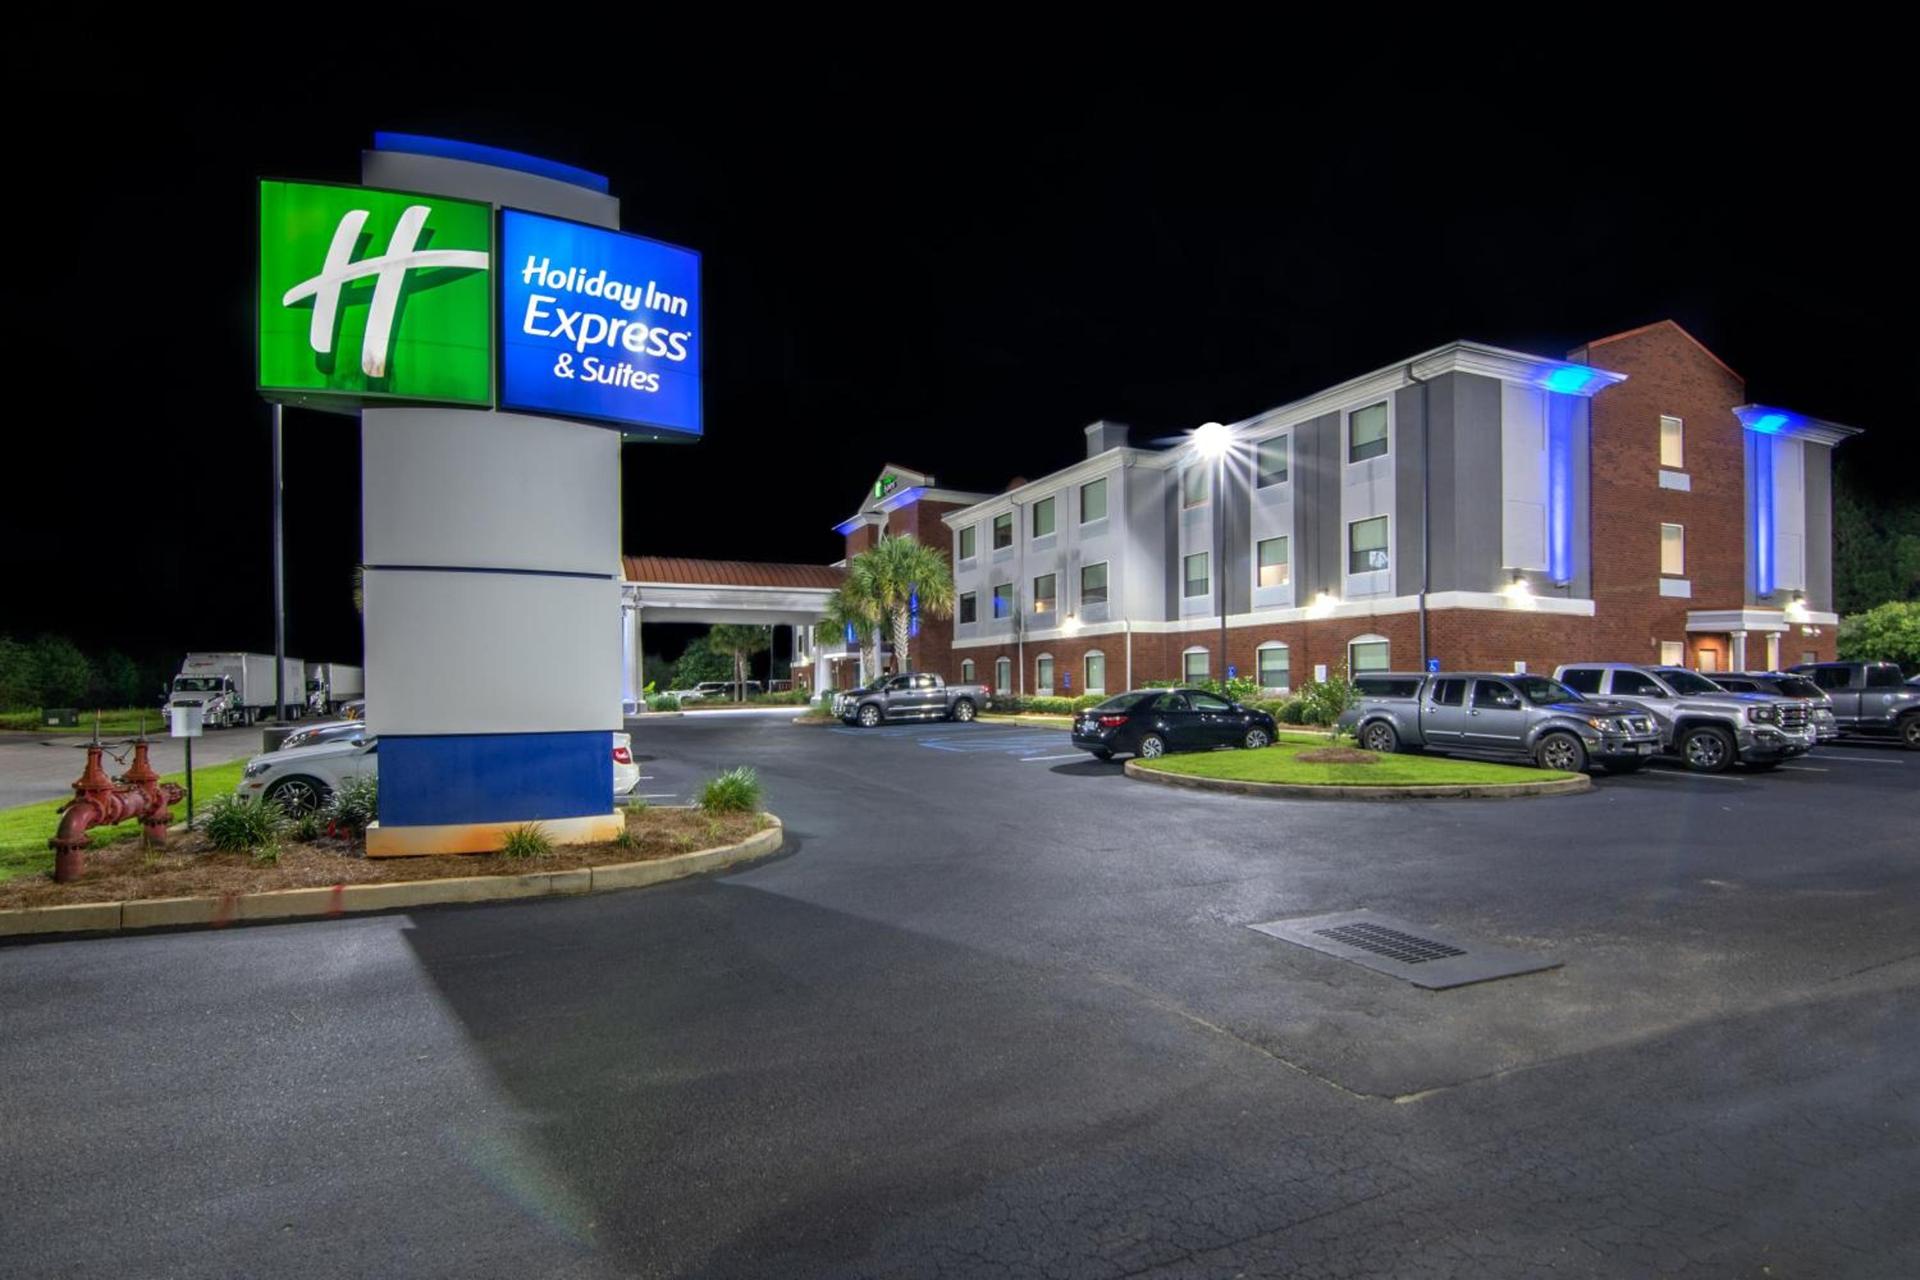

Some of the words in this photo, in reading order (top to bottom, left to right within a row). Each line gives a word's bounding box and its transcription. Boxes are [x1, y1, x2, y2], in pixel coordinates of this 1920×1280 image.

[522, 255, 643, 311] Holiday
[645, 280, 688, 317] Inn
[523, 293, 688, 362] Express
[553, 352, 575, 379] &
[580, 356, 661, 393] Suites
